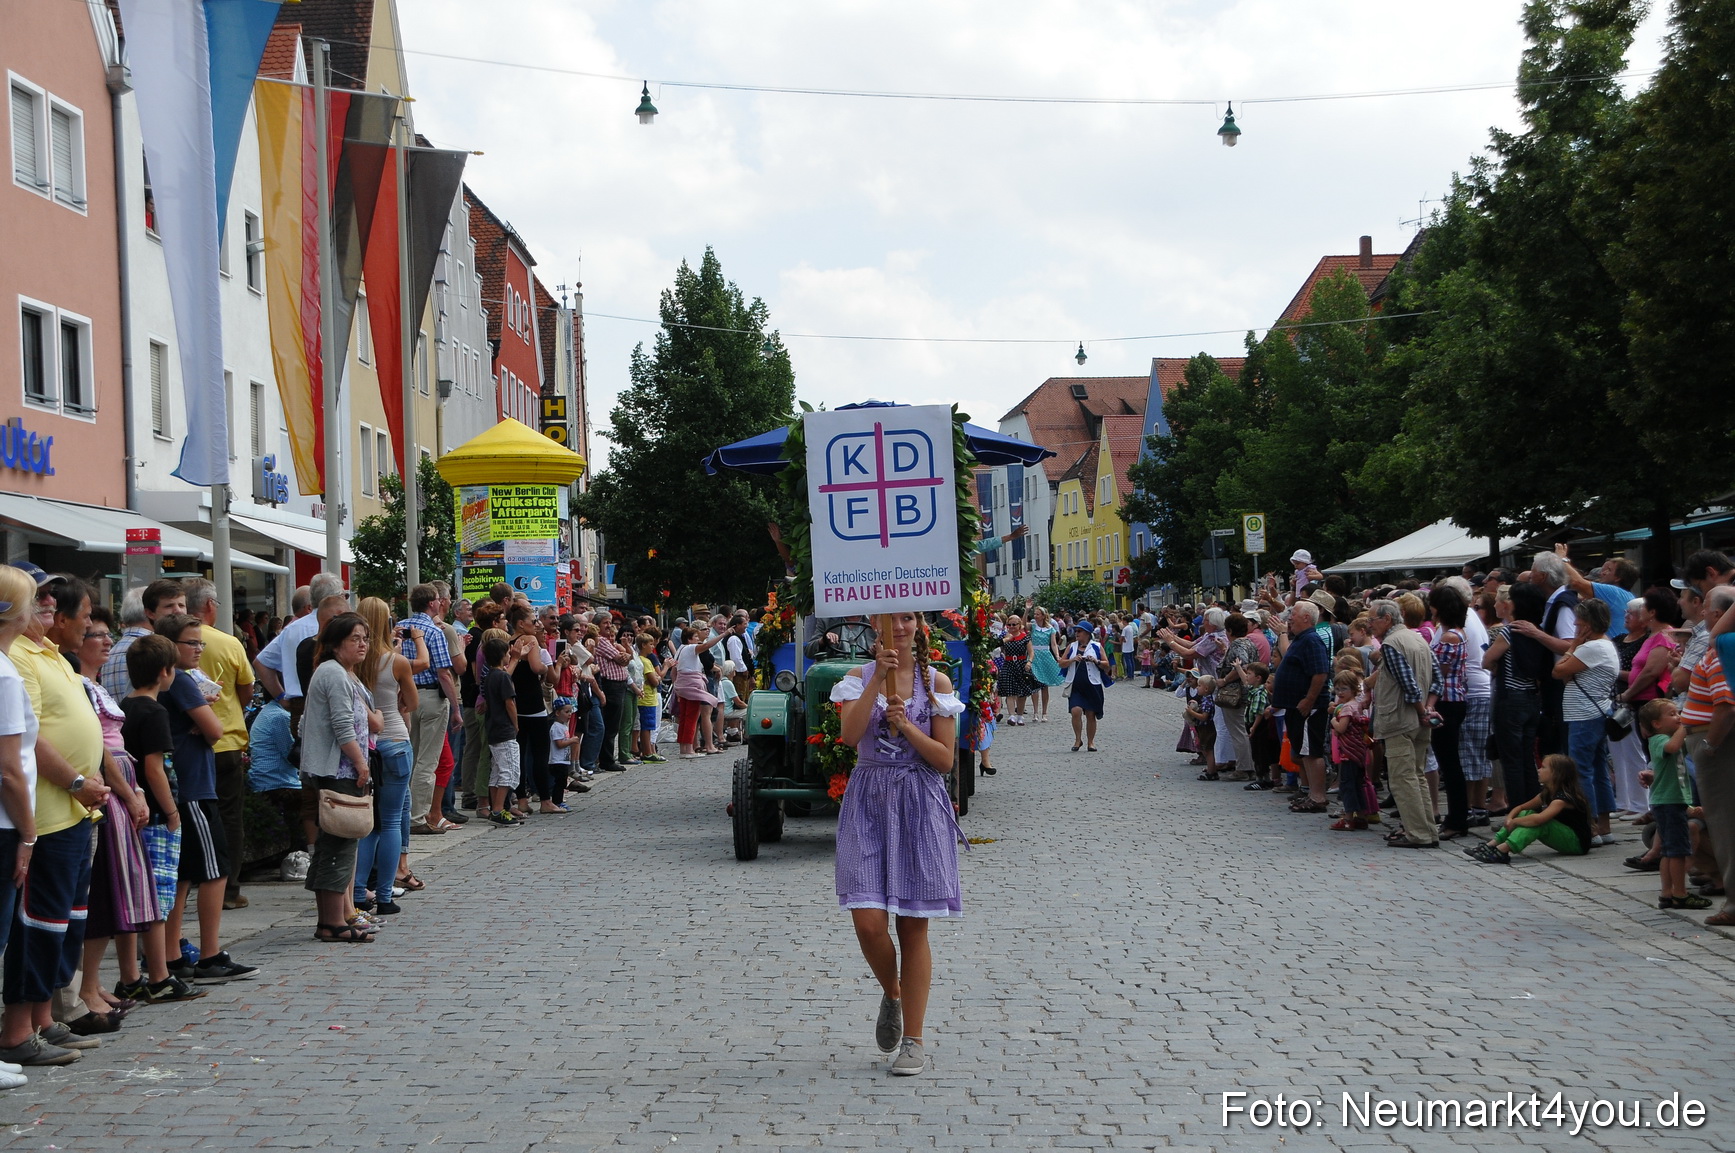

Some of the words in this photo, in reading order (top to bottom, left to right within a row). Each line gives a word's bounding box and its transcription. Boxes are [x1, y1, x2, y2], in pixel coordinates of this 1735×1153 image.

[492, 487, 512, 496] New
[515, 487, 540, 495] Berlin
[542, 487, 556, 495] Club
[492, 497, 557, 507] Volksfest
[824, 568, 892, 584] Katholischer
[895, 564, 948, 580] Deutscher
[463, 575, 505, 584] Jacobikirwa
[824, 580, 951, 603] FRAUENBUND
